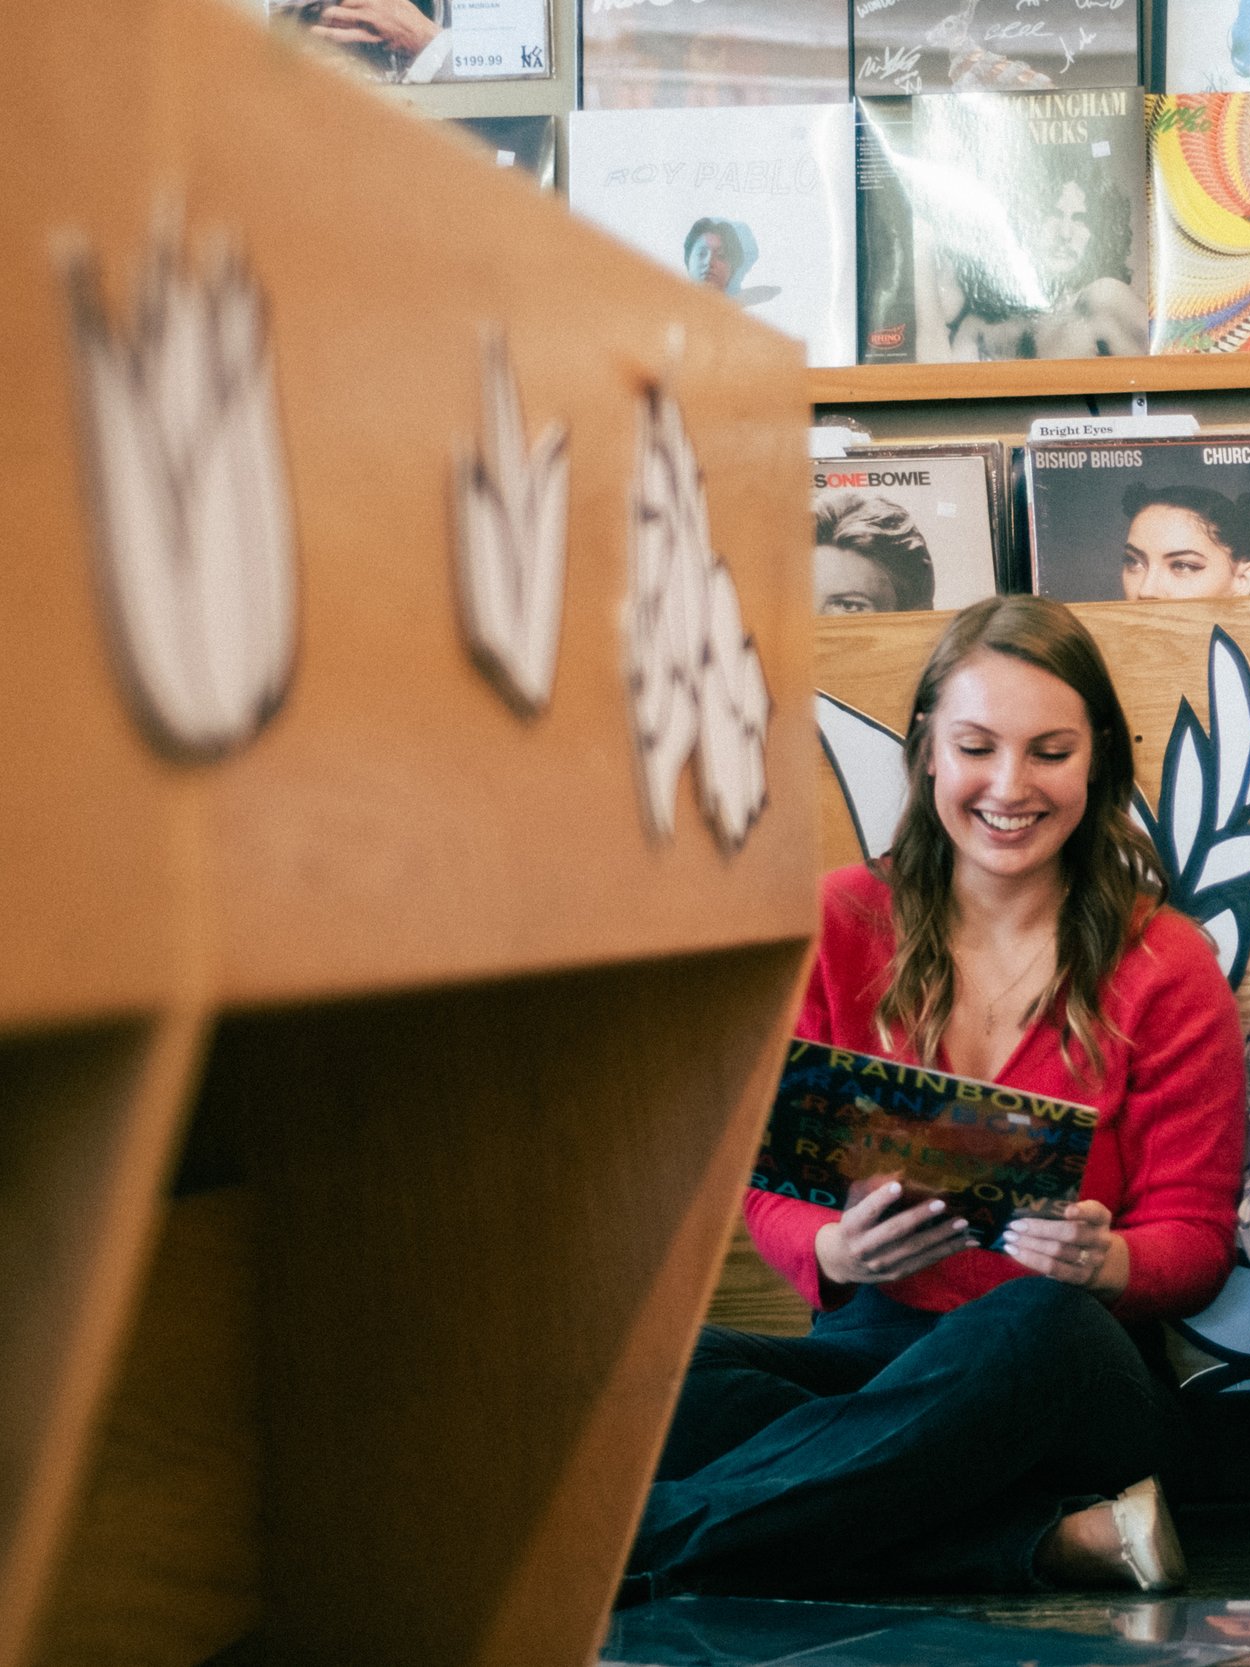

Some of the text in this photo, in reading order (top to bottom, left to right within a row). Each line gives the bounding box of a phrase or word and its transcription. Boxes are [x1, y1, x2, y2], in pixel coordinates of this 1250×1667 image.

[455, 55, 503, 67] $199.99
[1029, 120, 1088, 144] NICKS
[695, 152, 820, 195] PABLO
[871, 334, 901, 345] RHINO
[1039, 425, 1113, 438] Bright Eyes
[1035, 450, 1142, 468] BISHOP BRIGGS
[829, 1050, 1098, 1127] RAINBOWS
